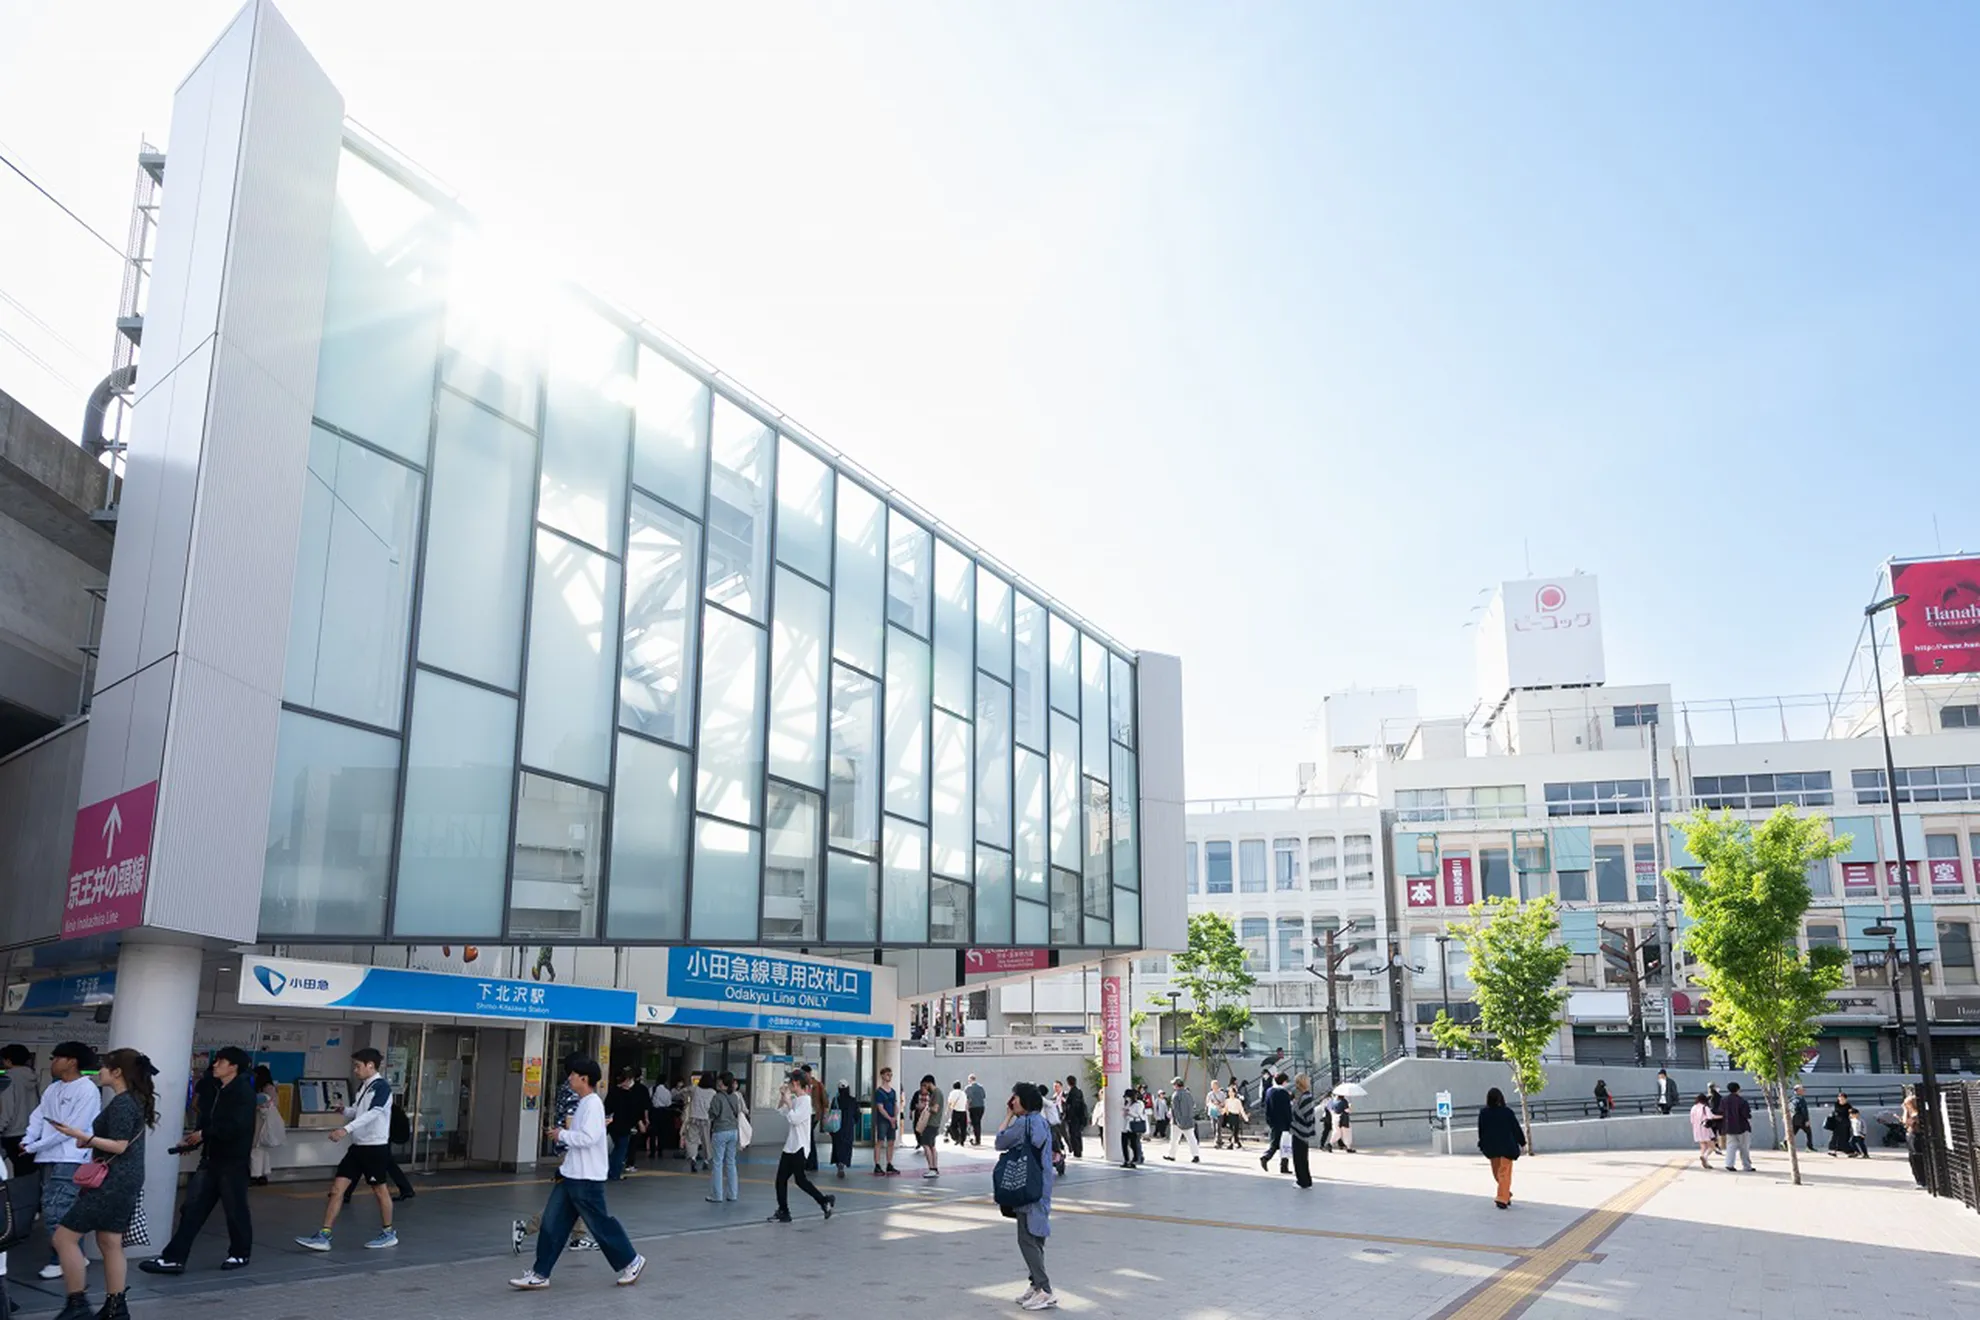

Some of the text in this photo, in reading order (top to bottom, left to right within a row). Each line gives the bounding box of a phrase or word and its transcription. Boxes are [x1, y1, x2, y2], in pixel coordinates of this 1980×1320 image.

[67, 854, 145, 910] 京王井の頭線
[1411, 882, 1433, 904] 本
[687, 950, 858, 994] 小田急線専用改札口
[289, 977, 329, 991] 小田急
[478, 983, 545, 1004] 下北沢駅
[725, 986, 829, 1008] Odakyu Line ONLY
[1107, 994, 1120, 1065] 京王井の頭線
